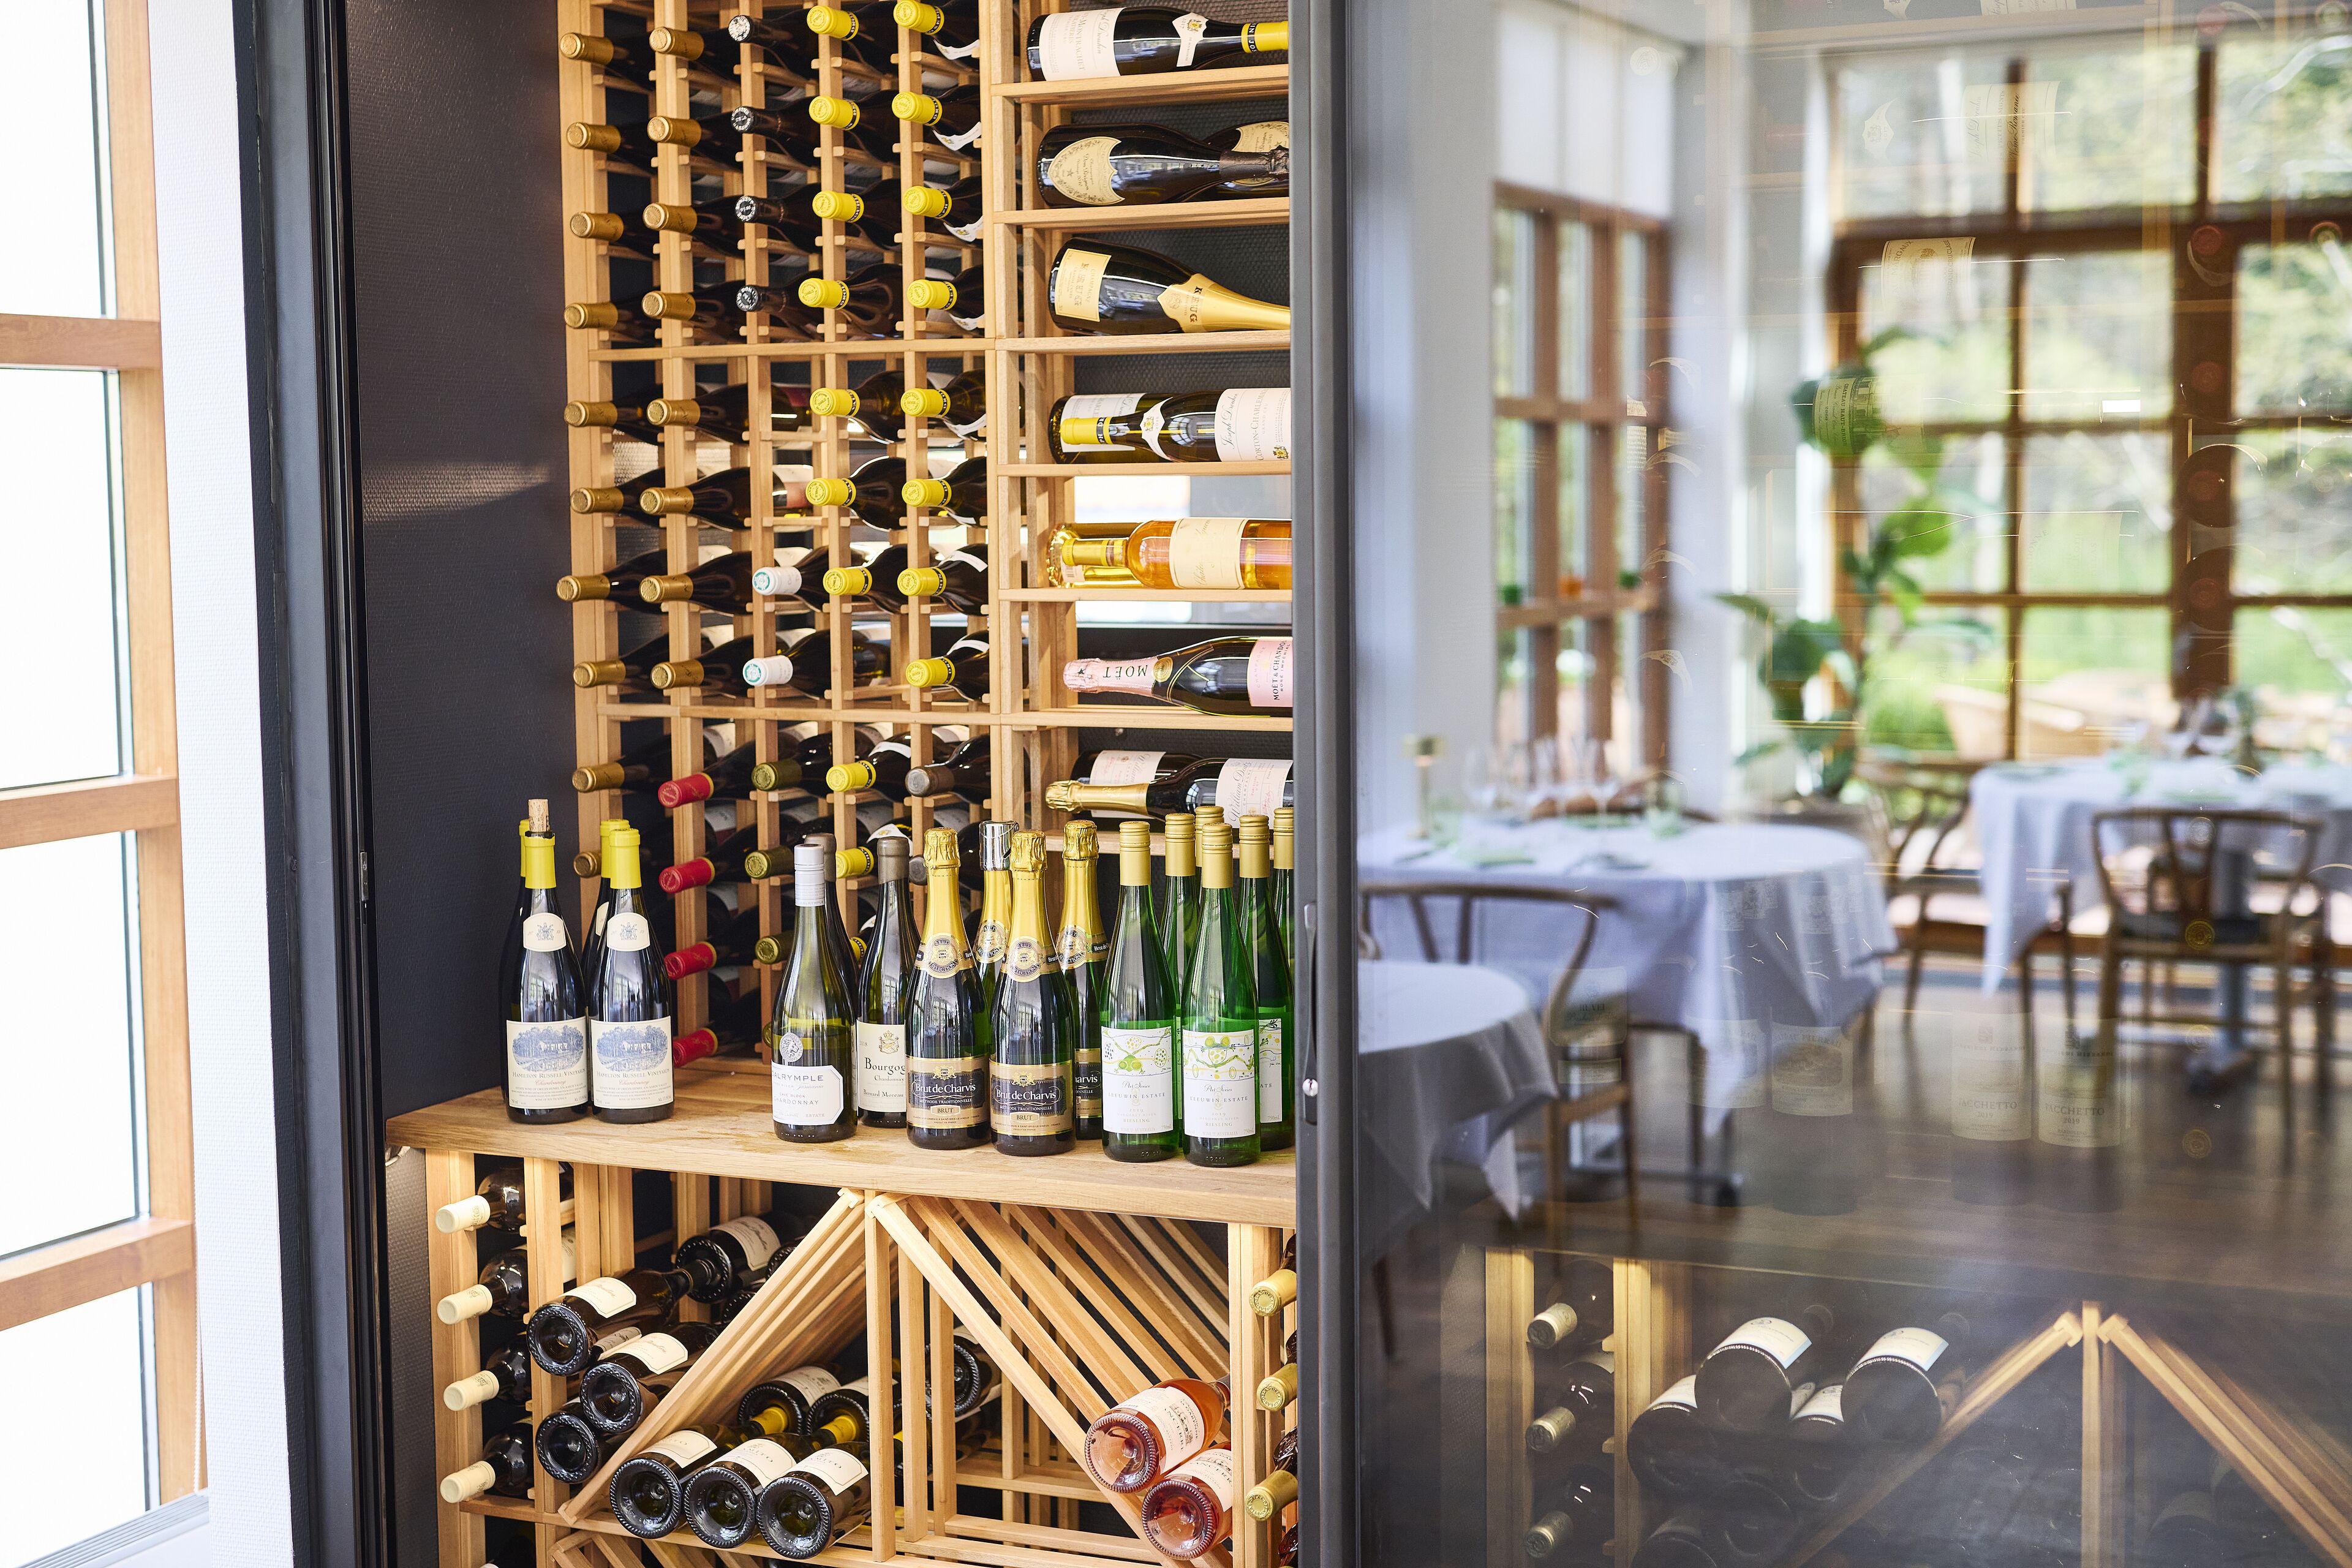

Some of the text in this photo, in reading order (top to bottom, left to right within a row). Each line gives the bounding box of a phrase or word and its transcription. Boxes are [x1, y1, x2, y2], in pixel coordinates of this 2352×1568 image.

[1074, 263, 1090, 306] KRUG
[1189, 286, 1203, 323] KRUG
[1221, 393, 1238, 450] Joseph Drouhin
[1103, 665, 1148, 679] MOËT
[1272, 679, 1280, 701] MOËT
[1227, 782, 1243, 821] William
[930, 960, 956, 972] SELECTION
[916, 1082, 976, 1093] Brut de Charvis
[997, 1090, 1057, 1100] Brut de Charvis
[774, 1096, 819, 1105] CHARDONNAY
